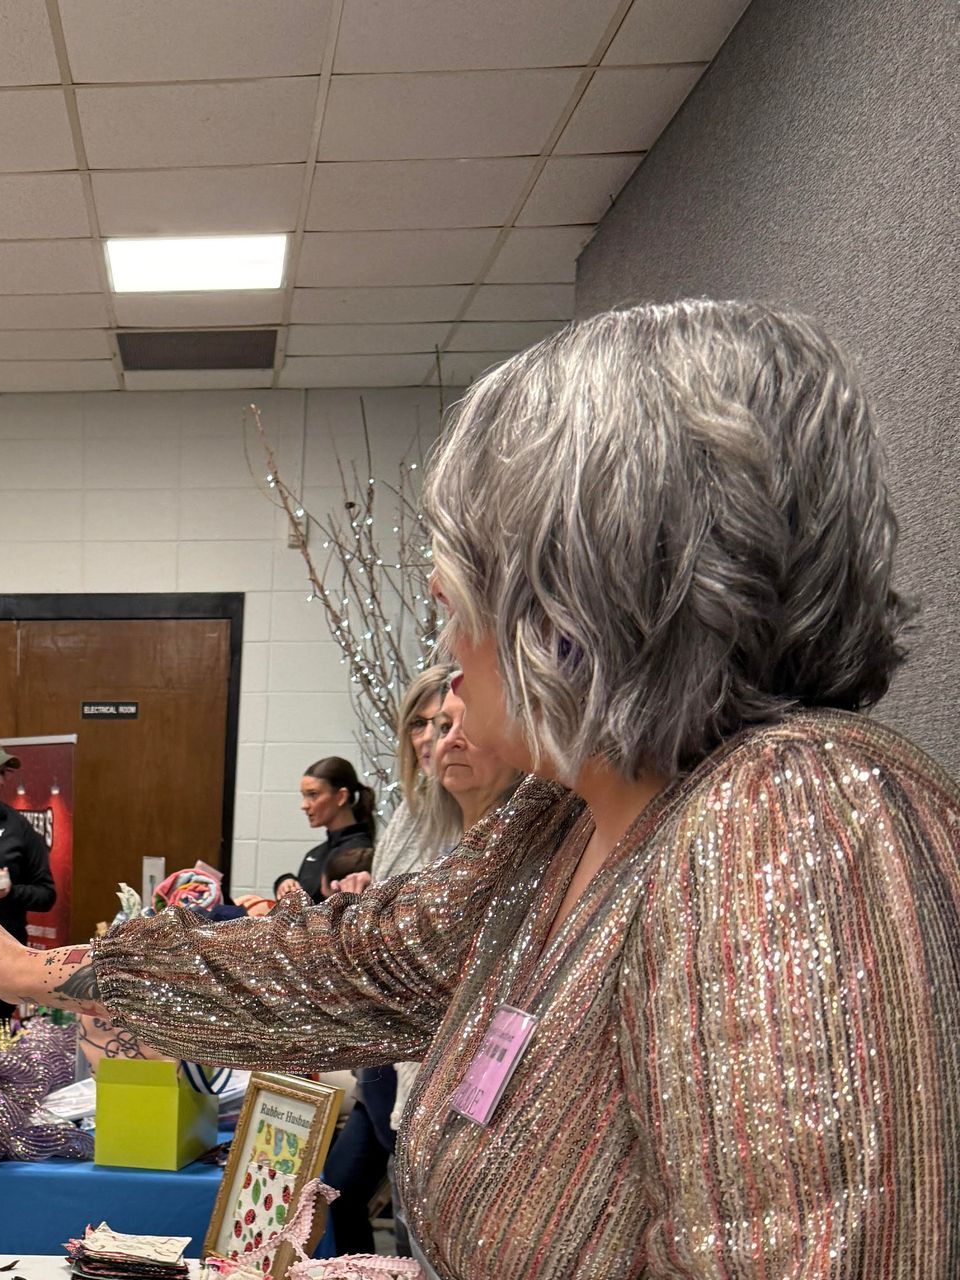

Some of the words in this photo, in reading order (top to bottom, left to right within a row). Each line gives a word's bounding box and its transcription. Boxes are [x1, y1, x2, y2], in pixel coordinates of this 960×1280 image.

[83, 706, 117, 714] ELECTRICAL
[118, 706, 137, 714] ROOM
[260, 1103, 285, 1120] Rubber
